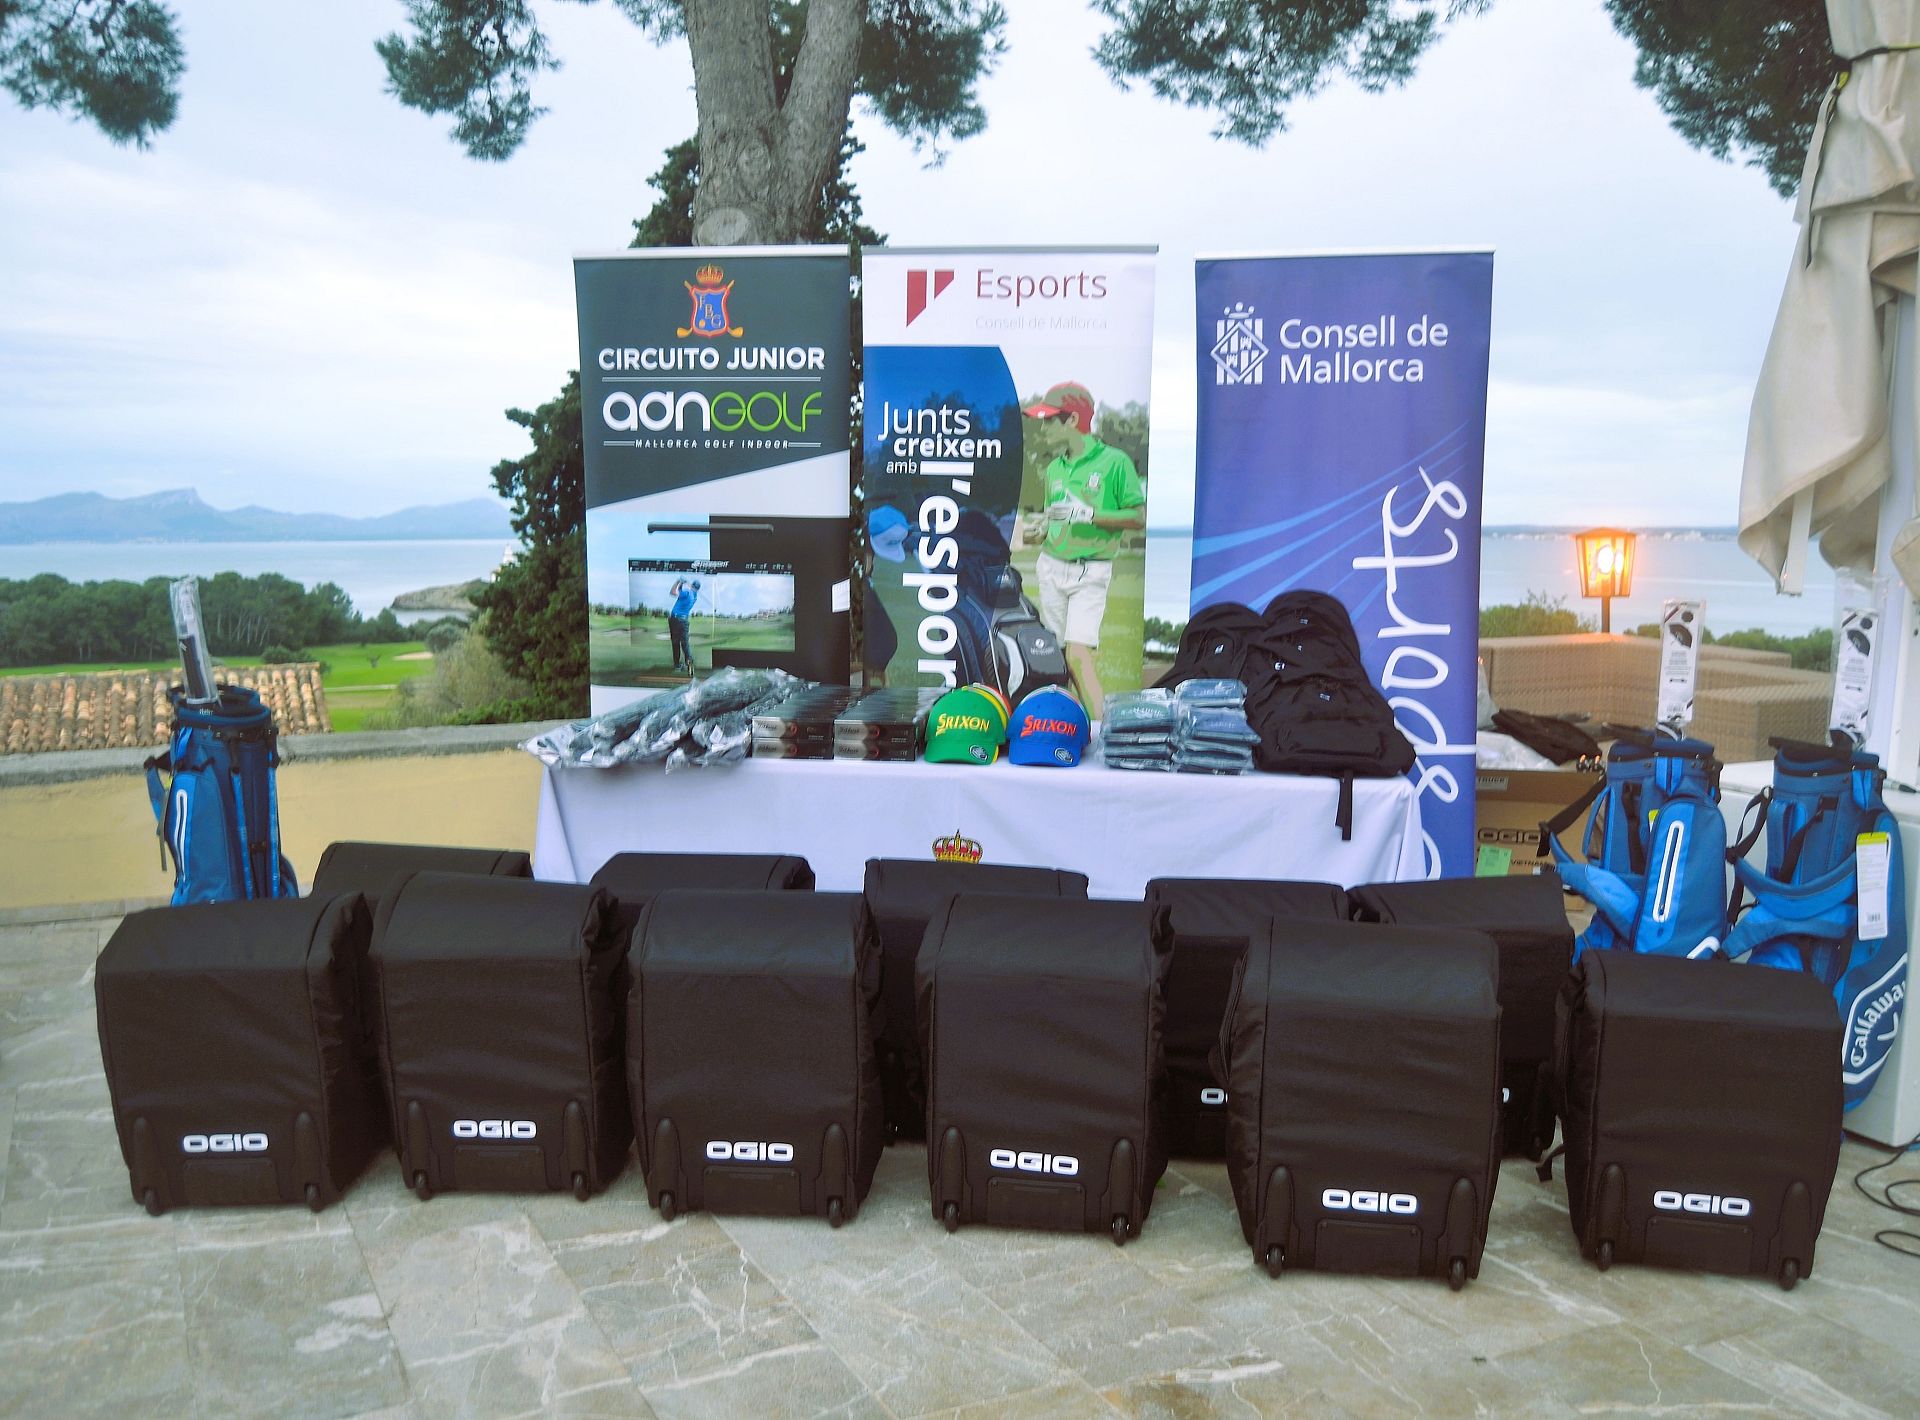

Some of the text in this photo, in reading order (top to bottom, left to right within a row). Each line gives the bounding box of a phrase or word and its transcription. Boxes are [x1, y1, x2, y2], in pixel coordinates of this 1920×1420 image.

[977, 268, 1107, 307] Esports
[975, 315, 1108, 330] Consell de Mallorca
[1279, 314, 1449, 349] Consell de
[598, 346, 825, 370] CIRCUITO JUNIOR
[1279, 351, 1425, 384] Mallorca
[877, 401, 971, 441] Junts
[635, 439, 789, 450] MALLORCA GOLF INDOOR
[893, 432, 1001, 458] creixem
[886, 459, 918, 474] amb
[902, 461, 975, 694] l'espor
[935, 713, 990, 737] SRIXON
[1020, 714, 1078, 738] SRIXON
[453, 1119, 537, 1139] OGIO
[183, 1133, 269, 1153] OGIO
[706, 1140, 794, 1162] OGIO
[989, 1149, 1079, 1175] OGIO
[1322, 1188, 1418, 1214] OGIO
[1653, 1190, 1751, 1217] OGIO
